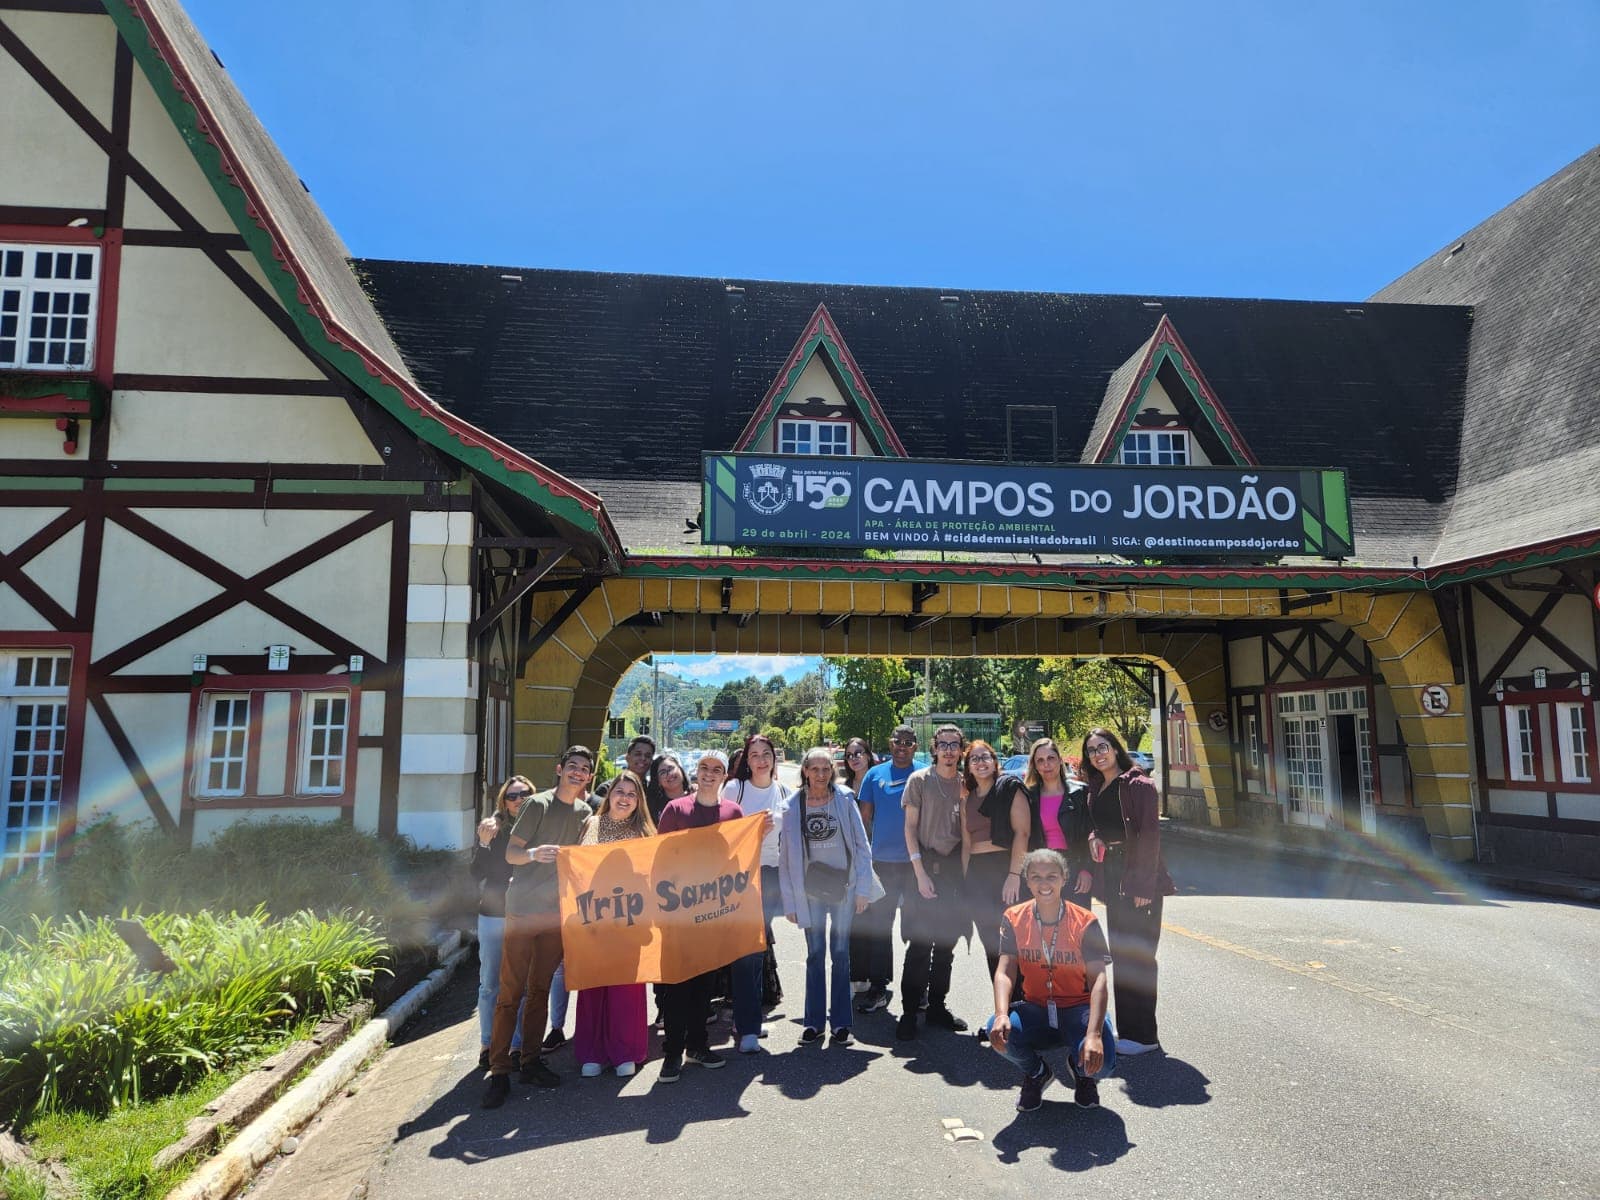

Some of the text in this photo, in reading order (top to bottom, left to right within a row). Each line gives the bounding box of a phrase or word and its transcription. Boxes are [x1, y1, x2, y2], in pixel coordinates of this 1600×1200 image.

[791, 474, 852, 510] 150
[863, 474, 1297, 521] CAMPOS DO JORDÃO
[742, 528, 757, 538] 29
[761, 528, 775, 538] de
[779, 529, 808, 539] abril
[820, 530, 851, 540] 2024
[864, 520, 885, 529] APA
[895, 518, 922, 529] ÁREA
[925, 521, 939, 529] DE
[942, 519, 995, 532] PROTEÇÃO
[998, 523, 1056, 532] AMBIENTAL
[864, 530, 1300, 550] BEM VINDO À #cidademaisaltadobrasil SIGA: @destinocamposdojordao
[576, 886, 644, 926] Trip
